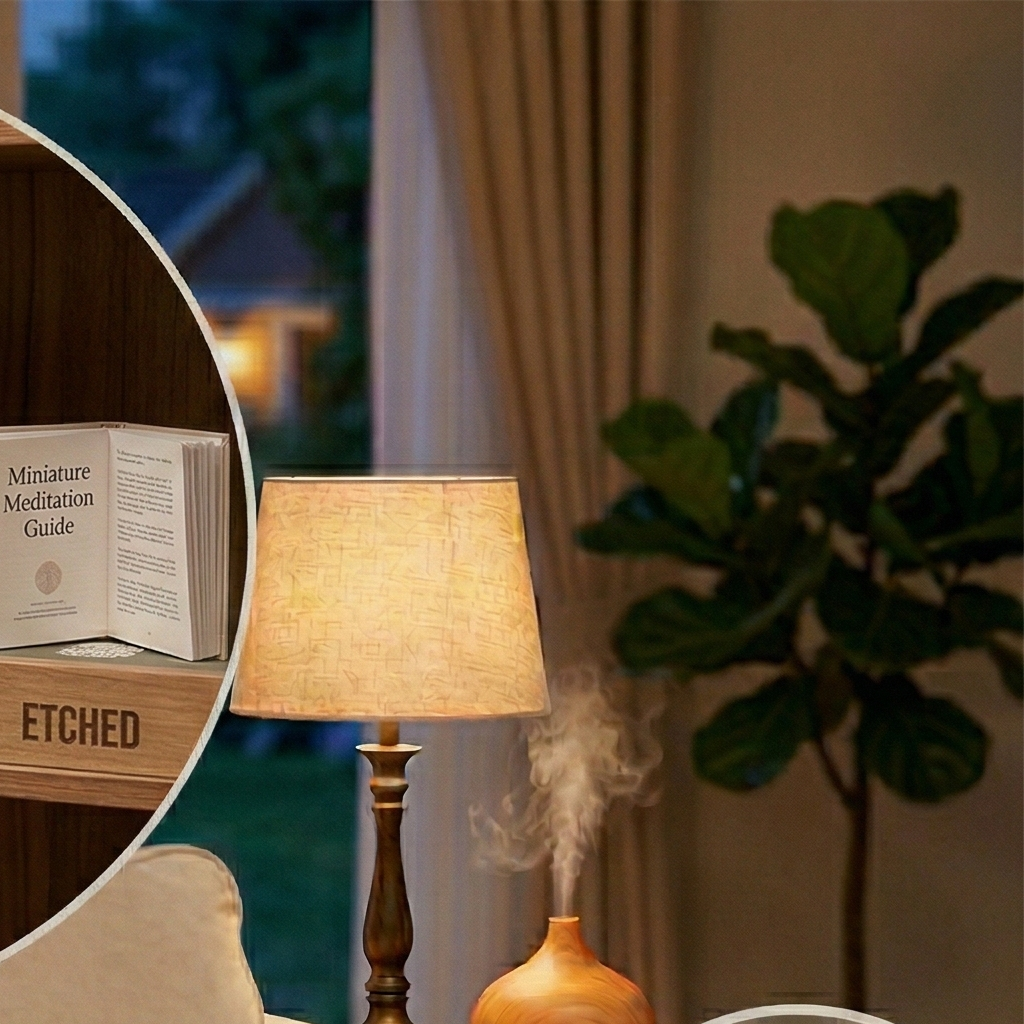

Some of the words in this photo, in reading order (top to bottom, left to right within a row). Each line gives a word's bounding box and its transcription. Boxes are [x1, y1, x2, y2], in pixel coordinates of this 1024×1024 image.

[7, 465, 91, 486] Miniature
[3, 490, 94, 513] Meditation
[24, 517, 74, 537] Guide
[21, 702, 140, 750] ETCHED
